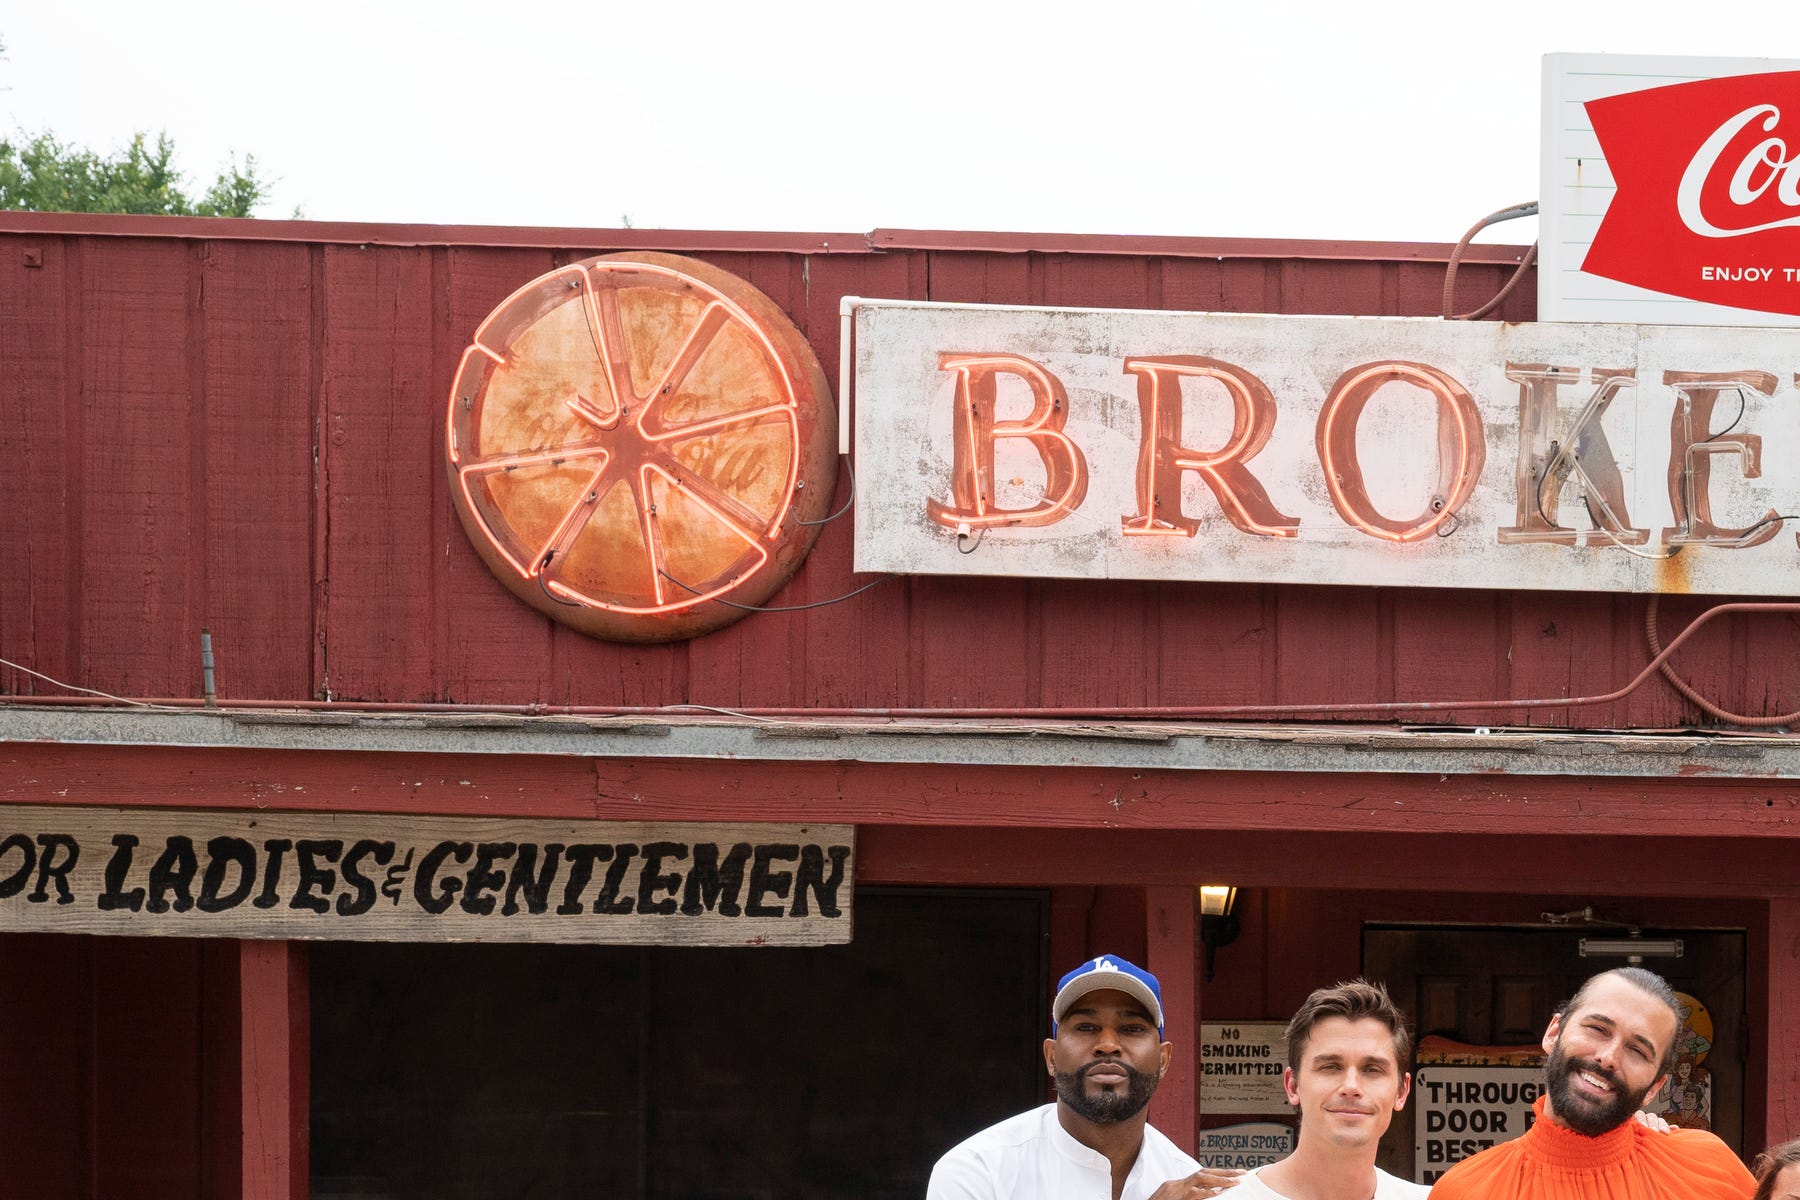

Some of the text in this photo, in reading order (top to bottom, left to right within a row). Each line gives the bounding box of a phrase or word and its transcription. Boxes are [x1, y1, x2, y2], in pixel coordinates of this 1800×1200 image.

[1701, 266, 1773, 282] ENJOY
[97, 833, 396, 915] LADIES
[413, 840, 852, 918] GENTLEMEN
[1221, 1027, 1240, 1040] NO
[1202, 1044, 1271, 1057] SMOKING
[1426, 1109, 1507, 1133] DOOR
[1207, 1134, 1248, 1150] BROKEN
[1250, 1134, 1289, 1153] SPOKE
[1200, 1154, 1276, 1168] VERAGES
